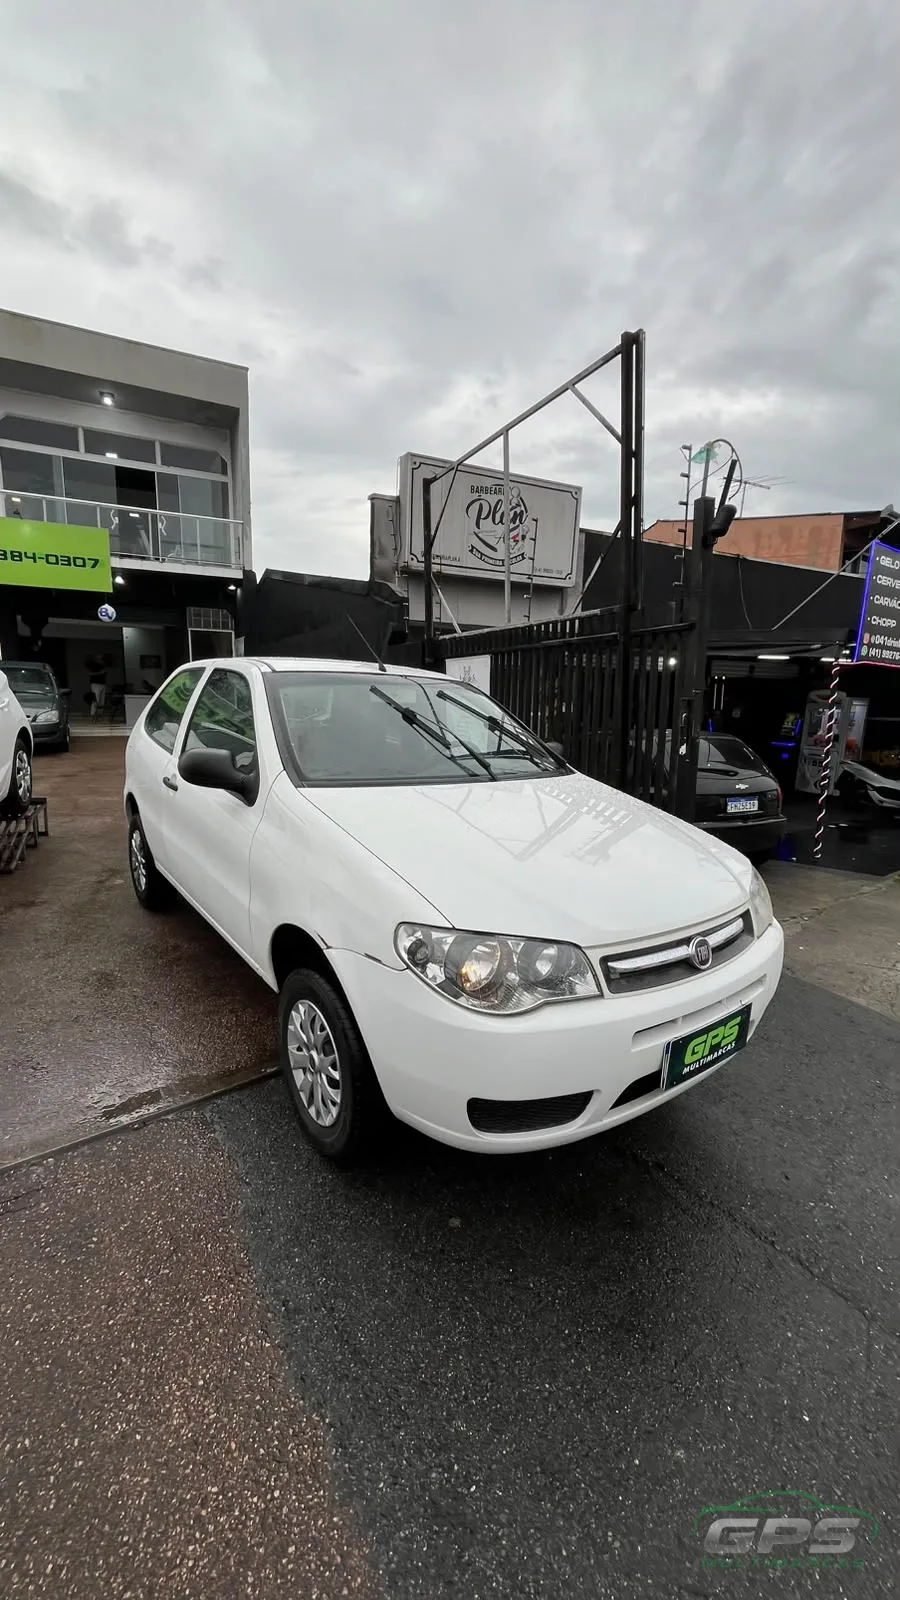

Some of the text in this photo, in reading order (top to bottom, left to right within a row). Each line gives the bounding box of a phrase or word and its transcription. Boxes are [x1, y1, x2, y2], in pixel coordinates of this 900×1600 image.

[470, 485, 506, 496] BARBEARI
[879, 555, 900, 570] GELO
[871, 615, 896, 629] CHOPP
[869, 647, 881, 658] (41)
[684, 1015, 742, 1065] GPS
[682, 1041, 736, 1075] MULTIMARCAS
